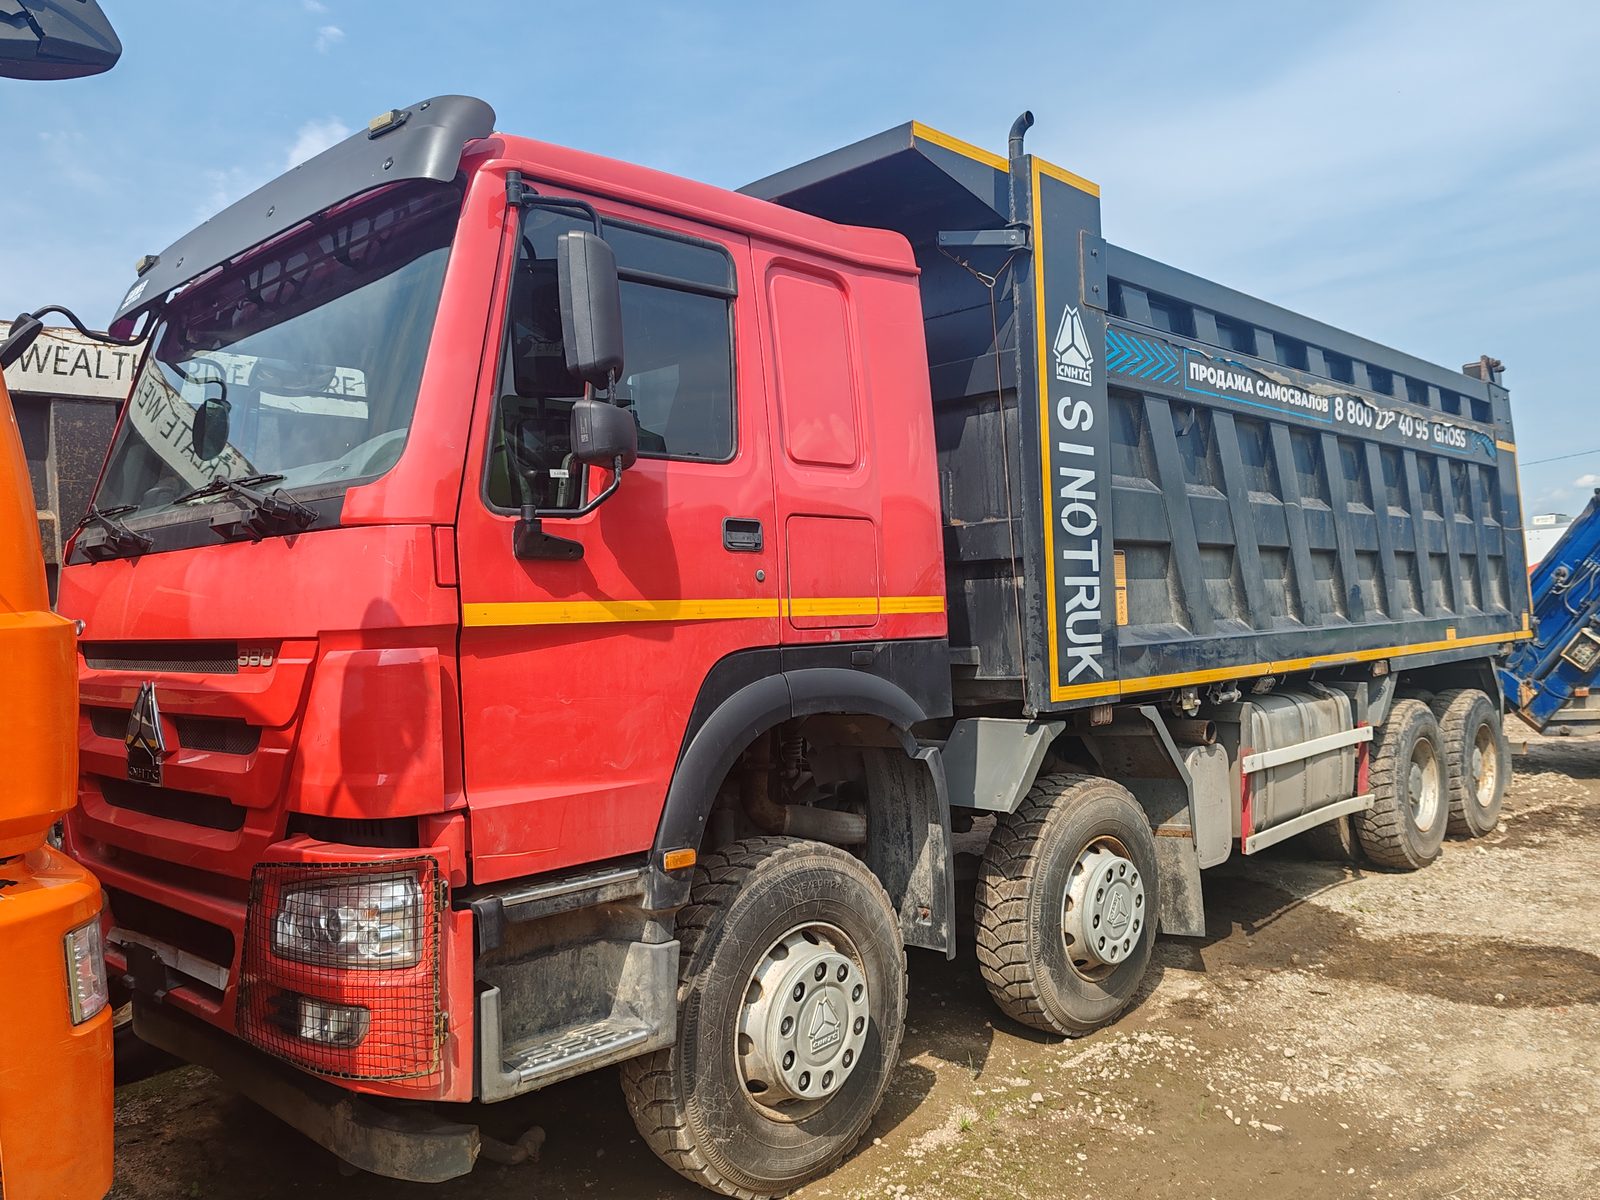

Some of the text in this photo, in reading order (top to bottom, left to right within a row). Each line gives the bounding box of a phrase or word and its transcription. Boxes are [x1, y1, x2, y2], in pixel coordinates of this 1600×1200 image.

[1058, 364, 1089, 382] CNHTC
[1189, 362, 1254, 395] ПРОДАЖА
[1256, 380, 1329, 413] САМОСВАЛОВ
[1335, 397, 1344, 421] 8
[1347, 400, 1372, 428] 800
[1398, 414, 1413, 437] 40
[1415, 419, 1429, 440] 95
[1057, 396, 1104, 683] SINOTRUK
